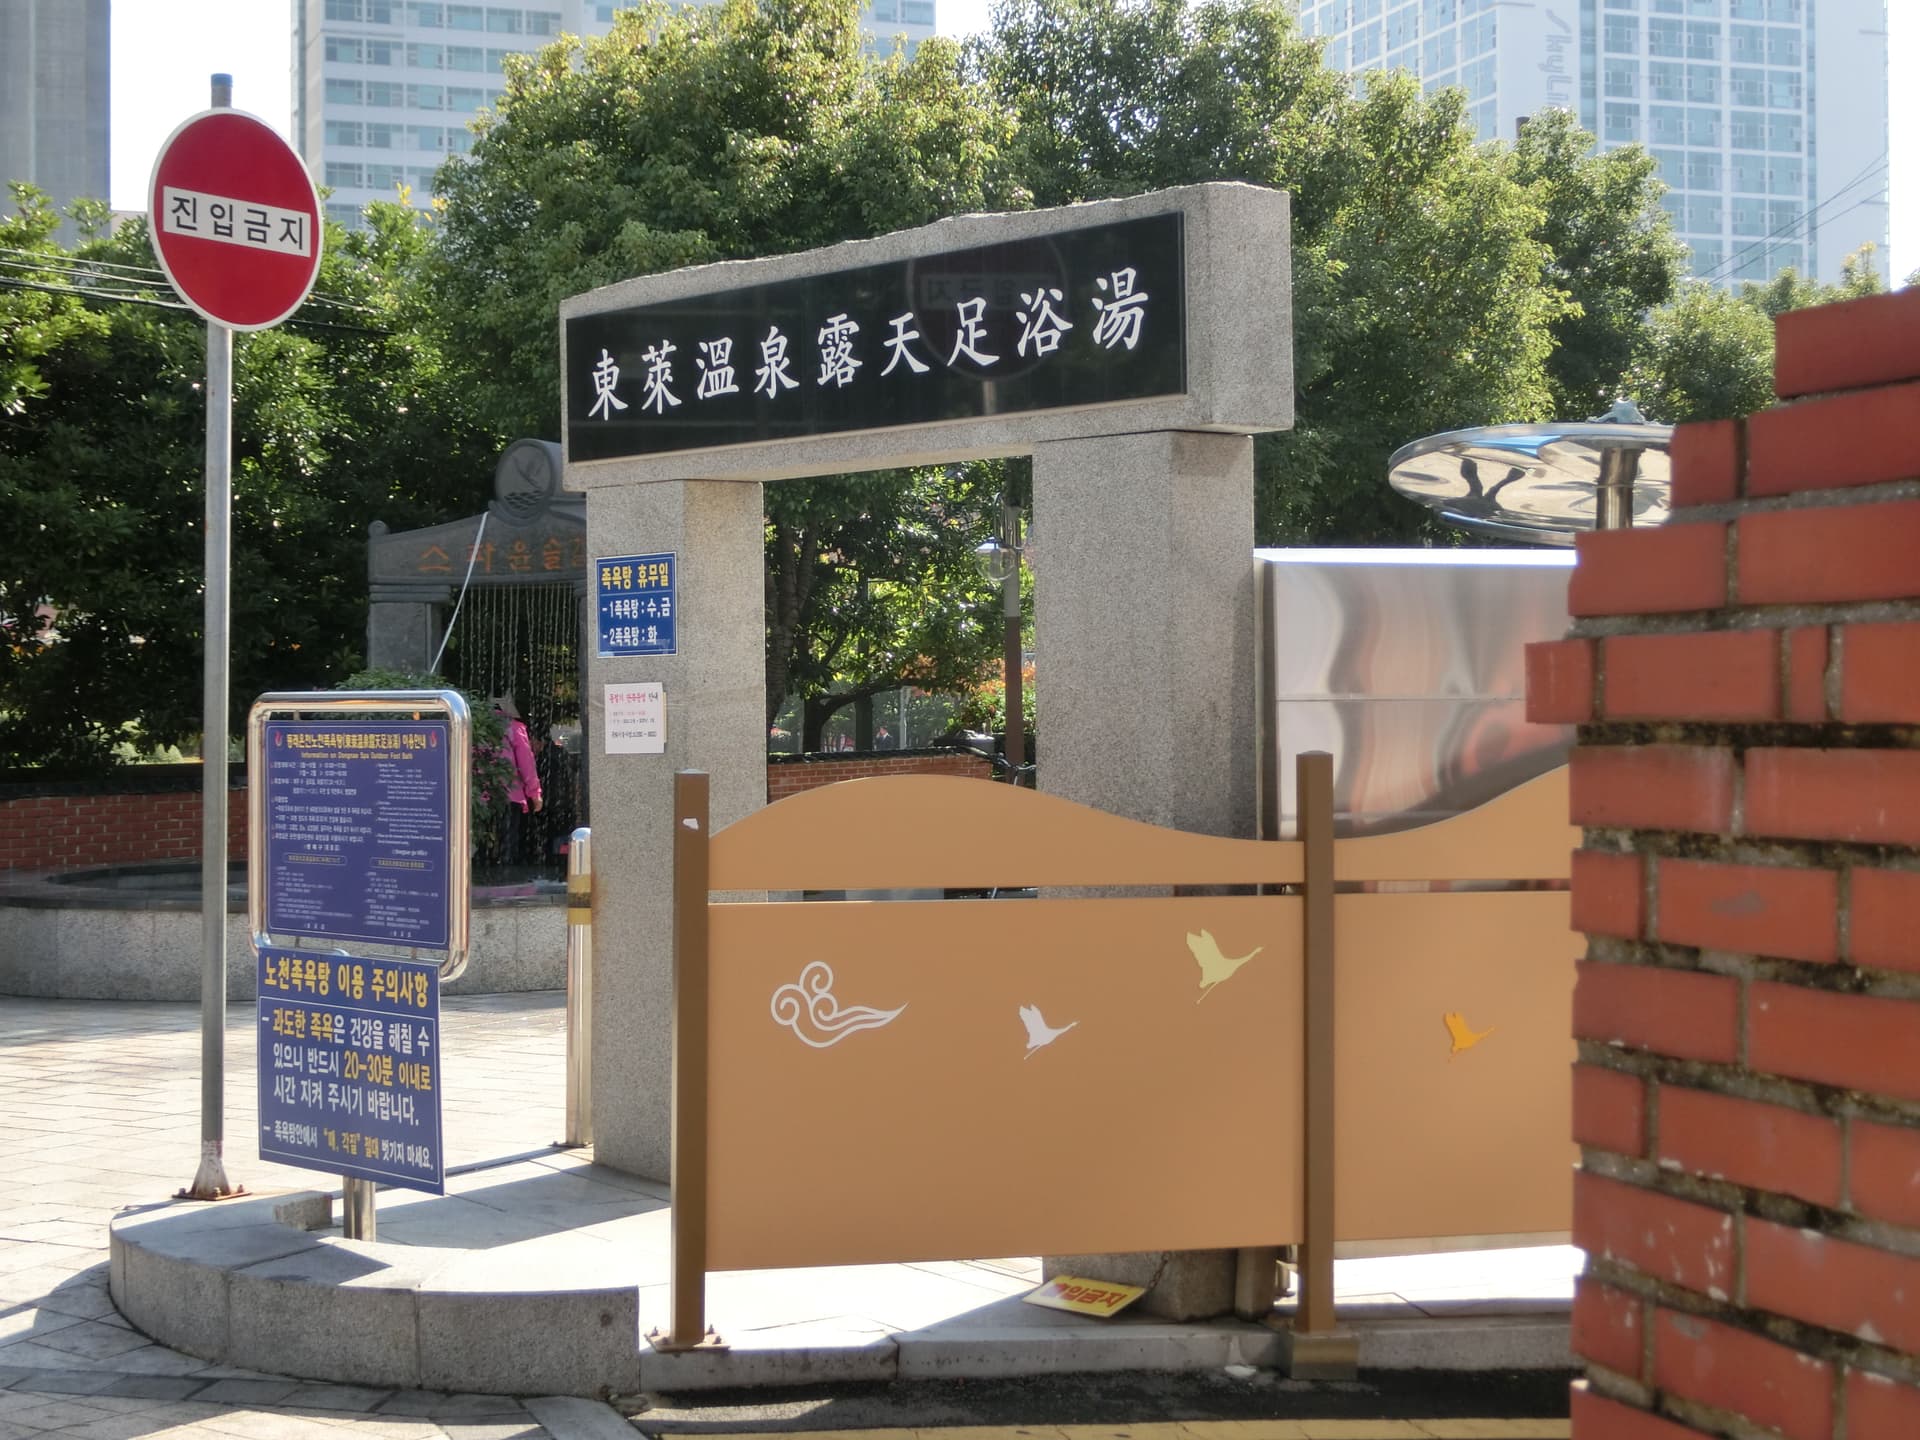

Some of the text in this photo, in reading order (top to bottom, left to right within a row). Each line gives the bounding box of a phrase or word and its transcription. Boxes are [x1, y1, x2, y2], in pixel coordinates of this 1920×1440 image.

[172, 196, 303, 250] 진입금지
[587, 266, 1149, 421] 東萊溫泉露天足浴湯
[601, 562, 669, 590] 족욕탕 휴무일
[264, 956, 428, 1008] 노천족욕탕 이용 주의사항
[272, 1008, 306, 1038] 과도한
[310, 1012, 345, 1043] 족욕은
[350, 1017, 384, 1050] 건강을
[388, 1022, 413, 1054] 해칠
[417, 1026, 430, 1057] 수
[273, 1042, 432, 1091] 있으니 반드시 20-30분 이내로
[274, 1075, 419, 1126] 시간 지켜 주시기 바랍니다.
[274, 1119, 318, 1148] 족욕탕안에서
[364, 1136, 379, 1159] 절대
[381, 1139, 405, 1164] 벗기지
